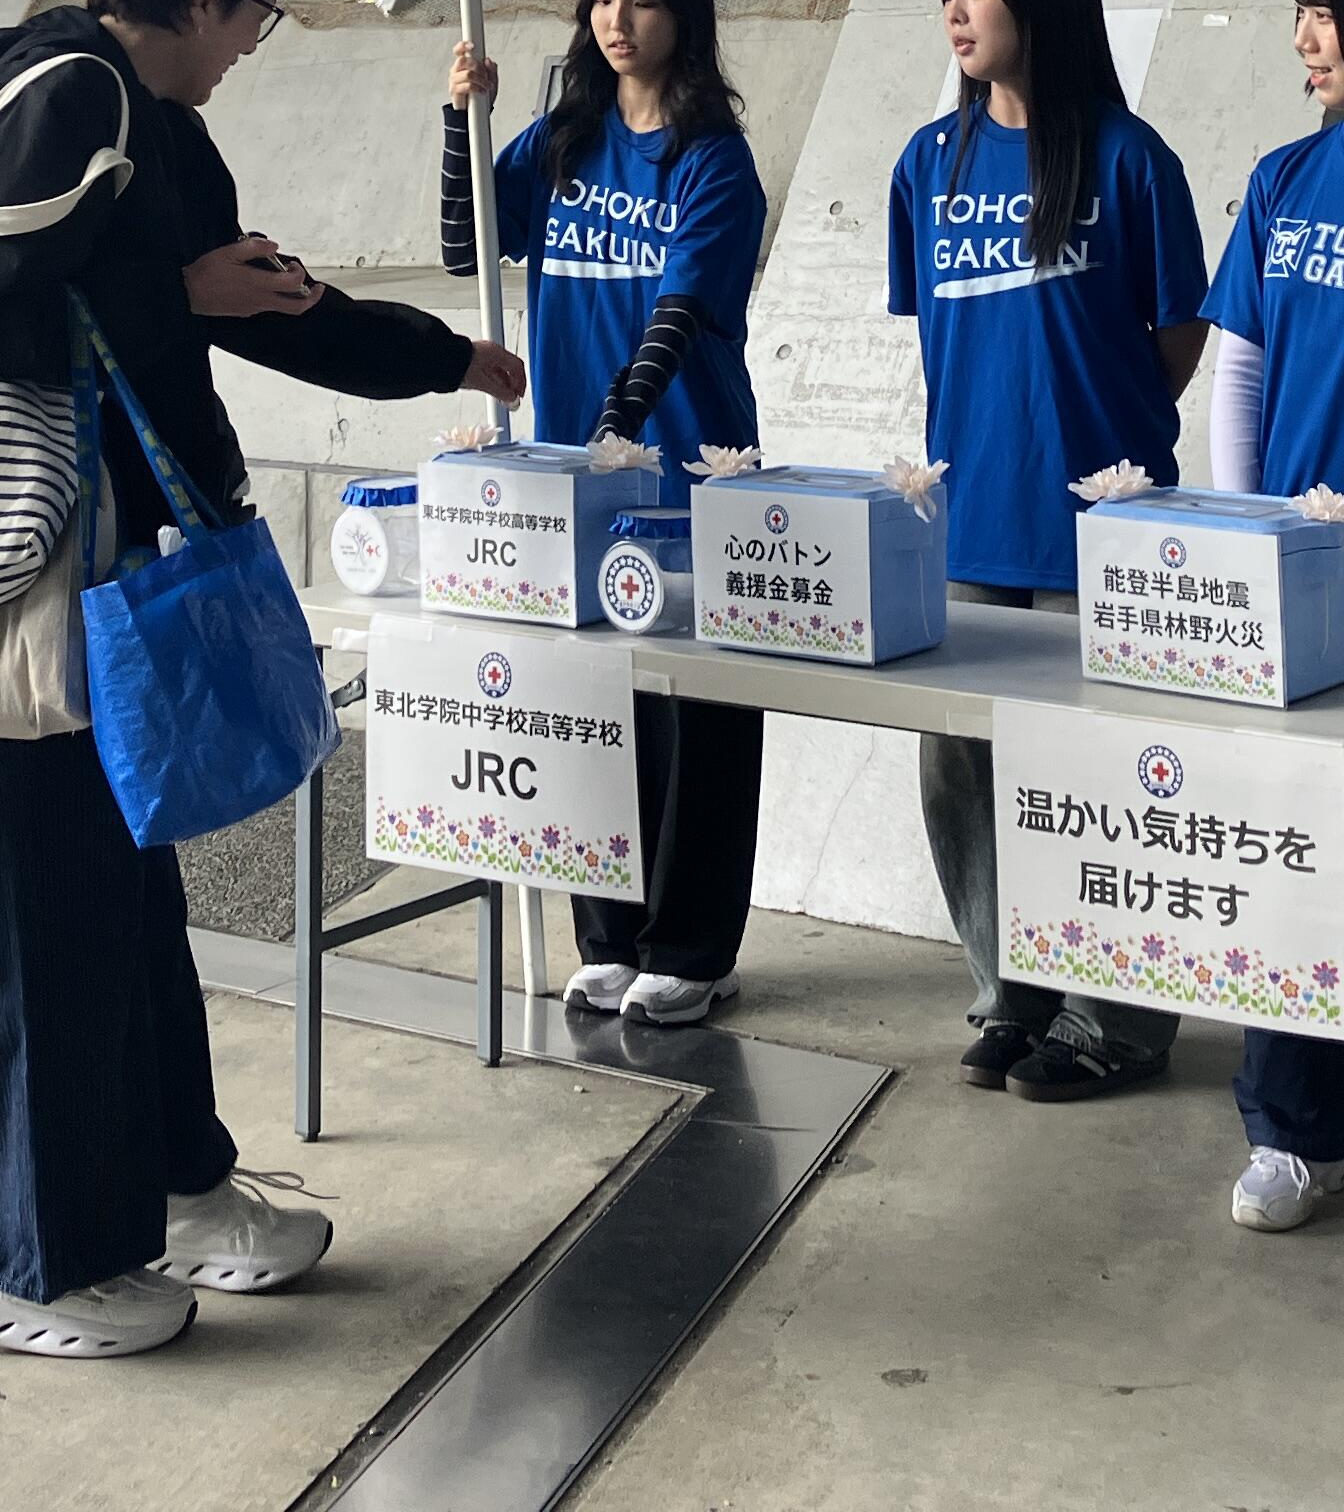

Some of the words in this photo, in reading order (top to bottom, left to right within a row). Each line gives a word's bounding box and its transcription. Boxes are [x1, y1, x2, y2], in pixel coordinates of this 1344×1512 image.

[931, 193, 1101, 225] TOHOU
[545, 217, 667, 268] GAKUIN
[933, 238, 1089, 270] GAKUN
[422, 504, 567, 534] 東北学院中学校高等学校
[467, 538, 517, 567] JRC
[724, 534, 832, 567] 心のバトン
[725, 570, 833, 606] 義援金募金
[1102, 564, 1251, 611] 能登半島地震
[1093, 601, 1265, 651] 岩手県林野火災
[374, 688, 624, 748] 東北学院中学校高等学校
[451, 749, 538, 800] JRC
[1016, 785, 1318, 875] 温かい気持ちを
[1078, 860, 1250, 928] 届けます
